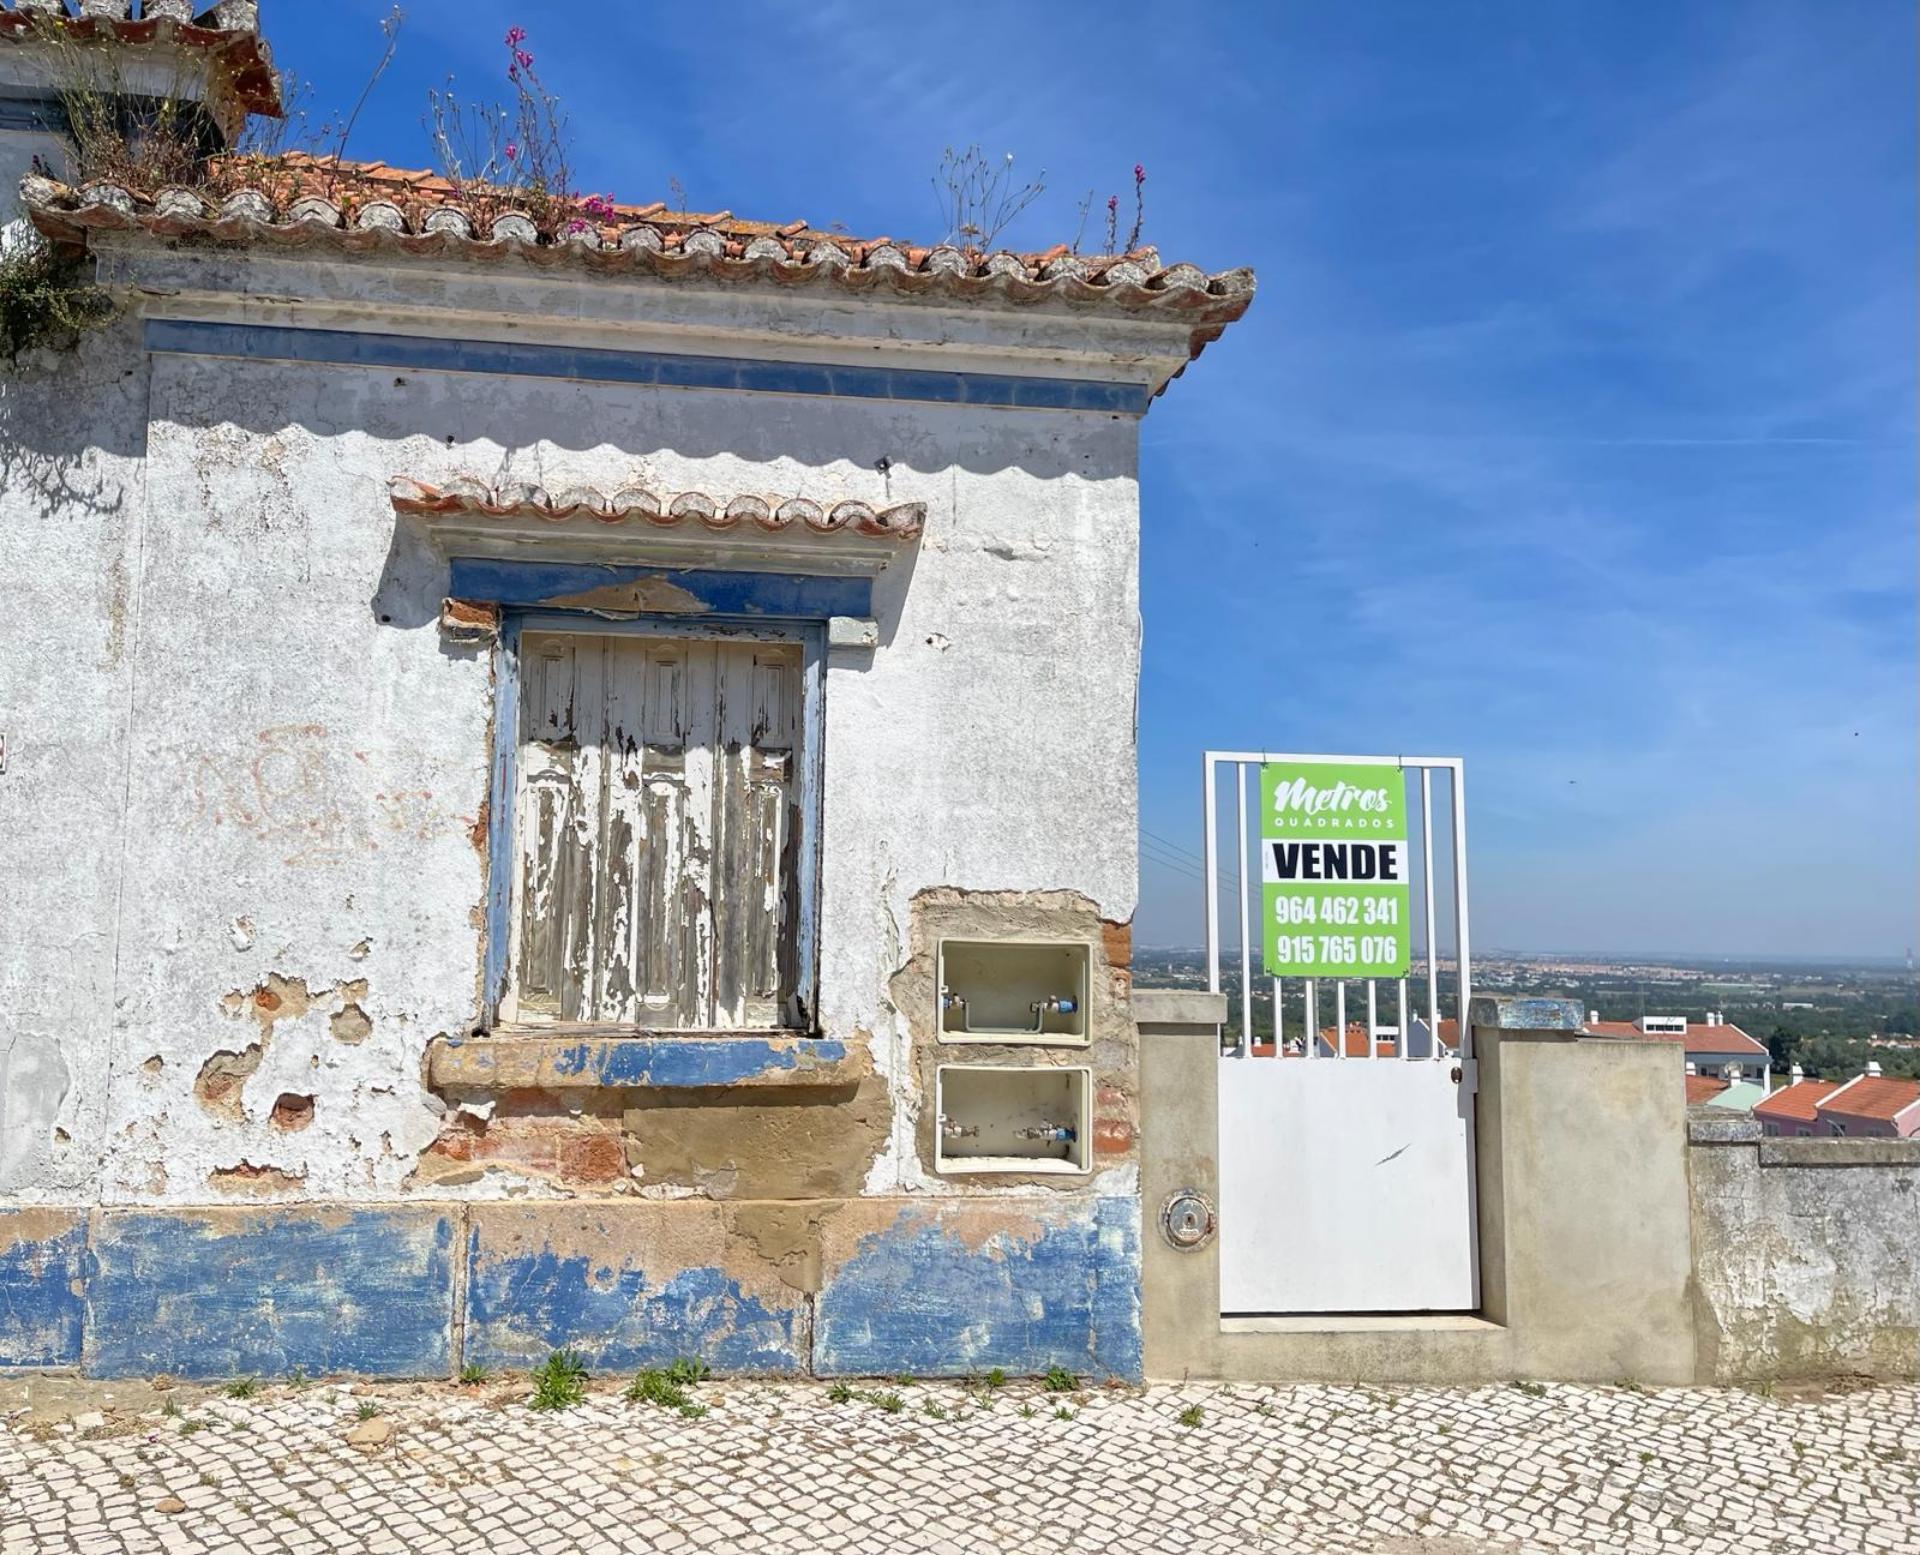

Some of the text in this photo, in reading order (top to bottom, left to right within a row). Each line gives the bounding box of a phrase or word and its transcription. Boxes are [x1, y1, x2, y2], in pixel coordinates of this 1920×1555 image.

[1274, 777, 1392, 815] Metros
[1274, 817, 1395, 828] QUADRADOS
[1272, 843, 1398, 880] VENDE
[1275, 895, 1398, 925] 964 462 341
[1277, 935, 1397, 964] 915 765 076
